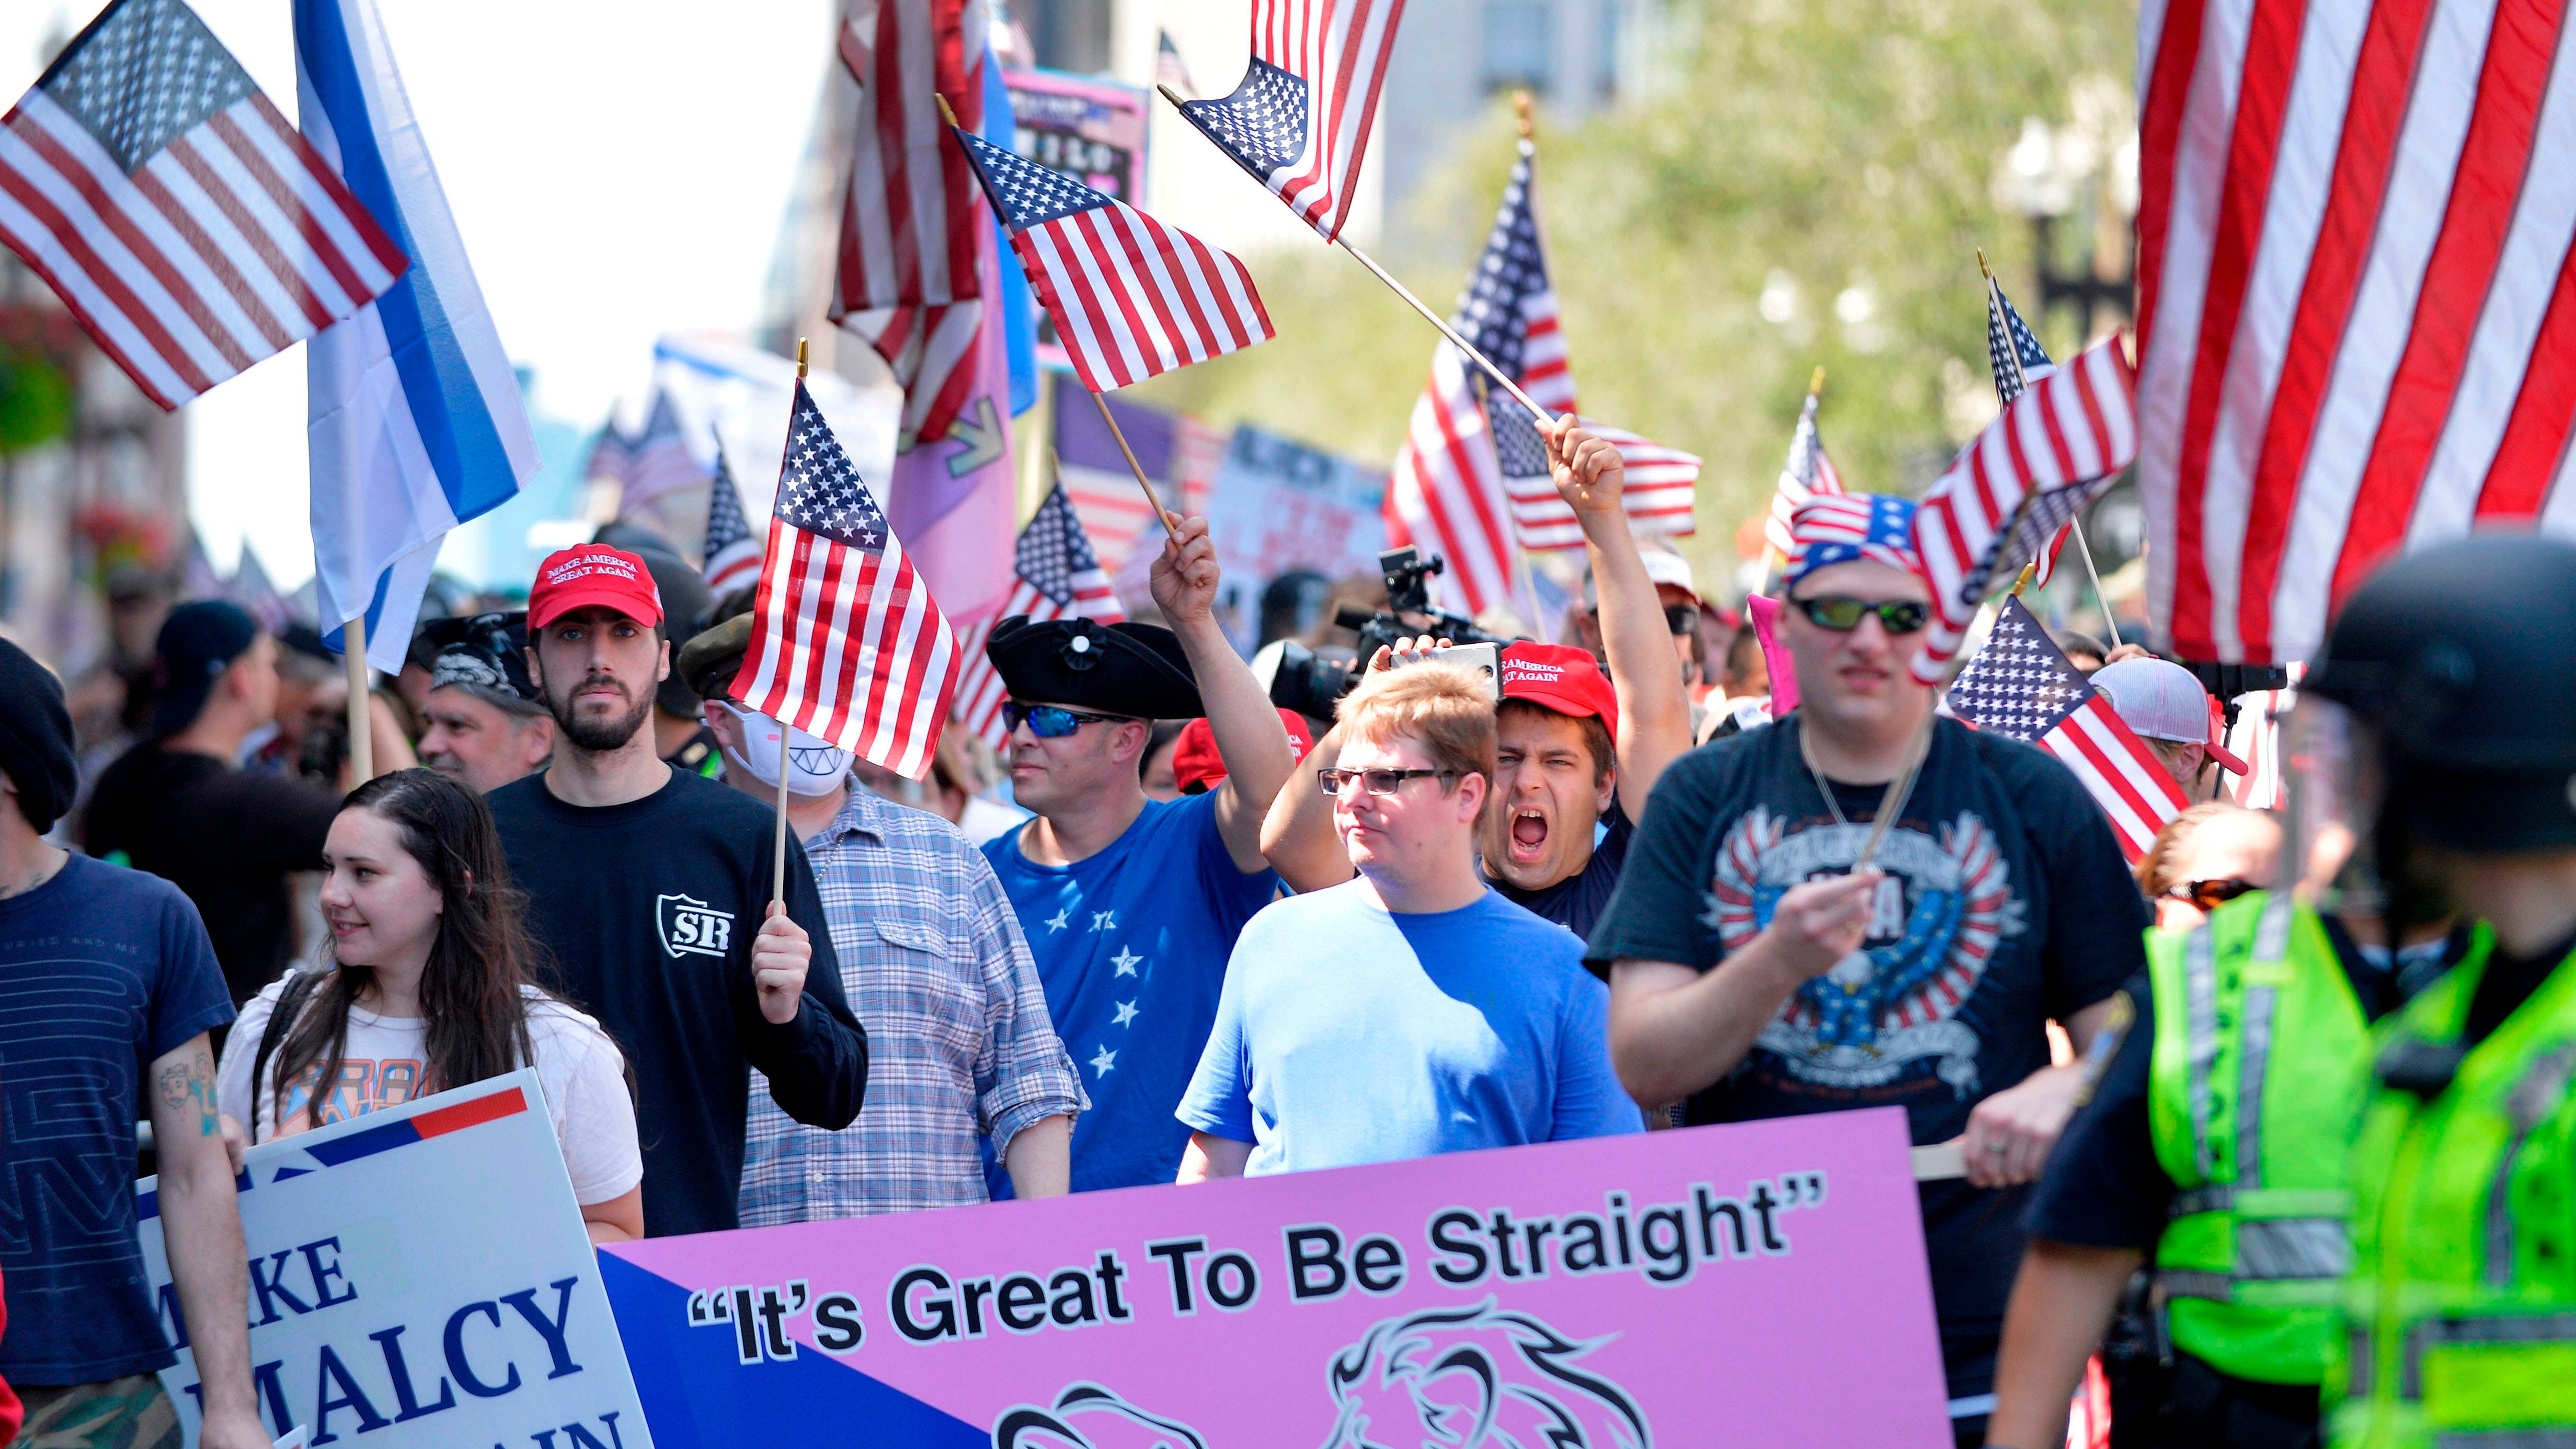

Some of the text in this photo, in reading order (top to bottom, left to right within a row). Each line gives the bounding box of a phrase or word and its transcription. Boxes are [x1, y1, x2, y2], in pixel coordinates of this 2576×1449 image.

[547, 555, 638, 579] MAKE AMERICA
[552, 566, 636, 585] GREAT AGAIN
[1506, 658, 1565, 673] AMERICA
[1517, 671, 1558, 682] AGAIN
[887, 1248, 1131, 1346] Great
[1146, 1234, 1260, 1317] To
[1283, 1222, 1406, 1304] Be
[1426, 1171, 1827, 1287] Straight”
